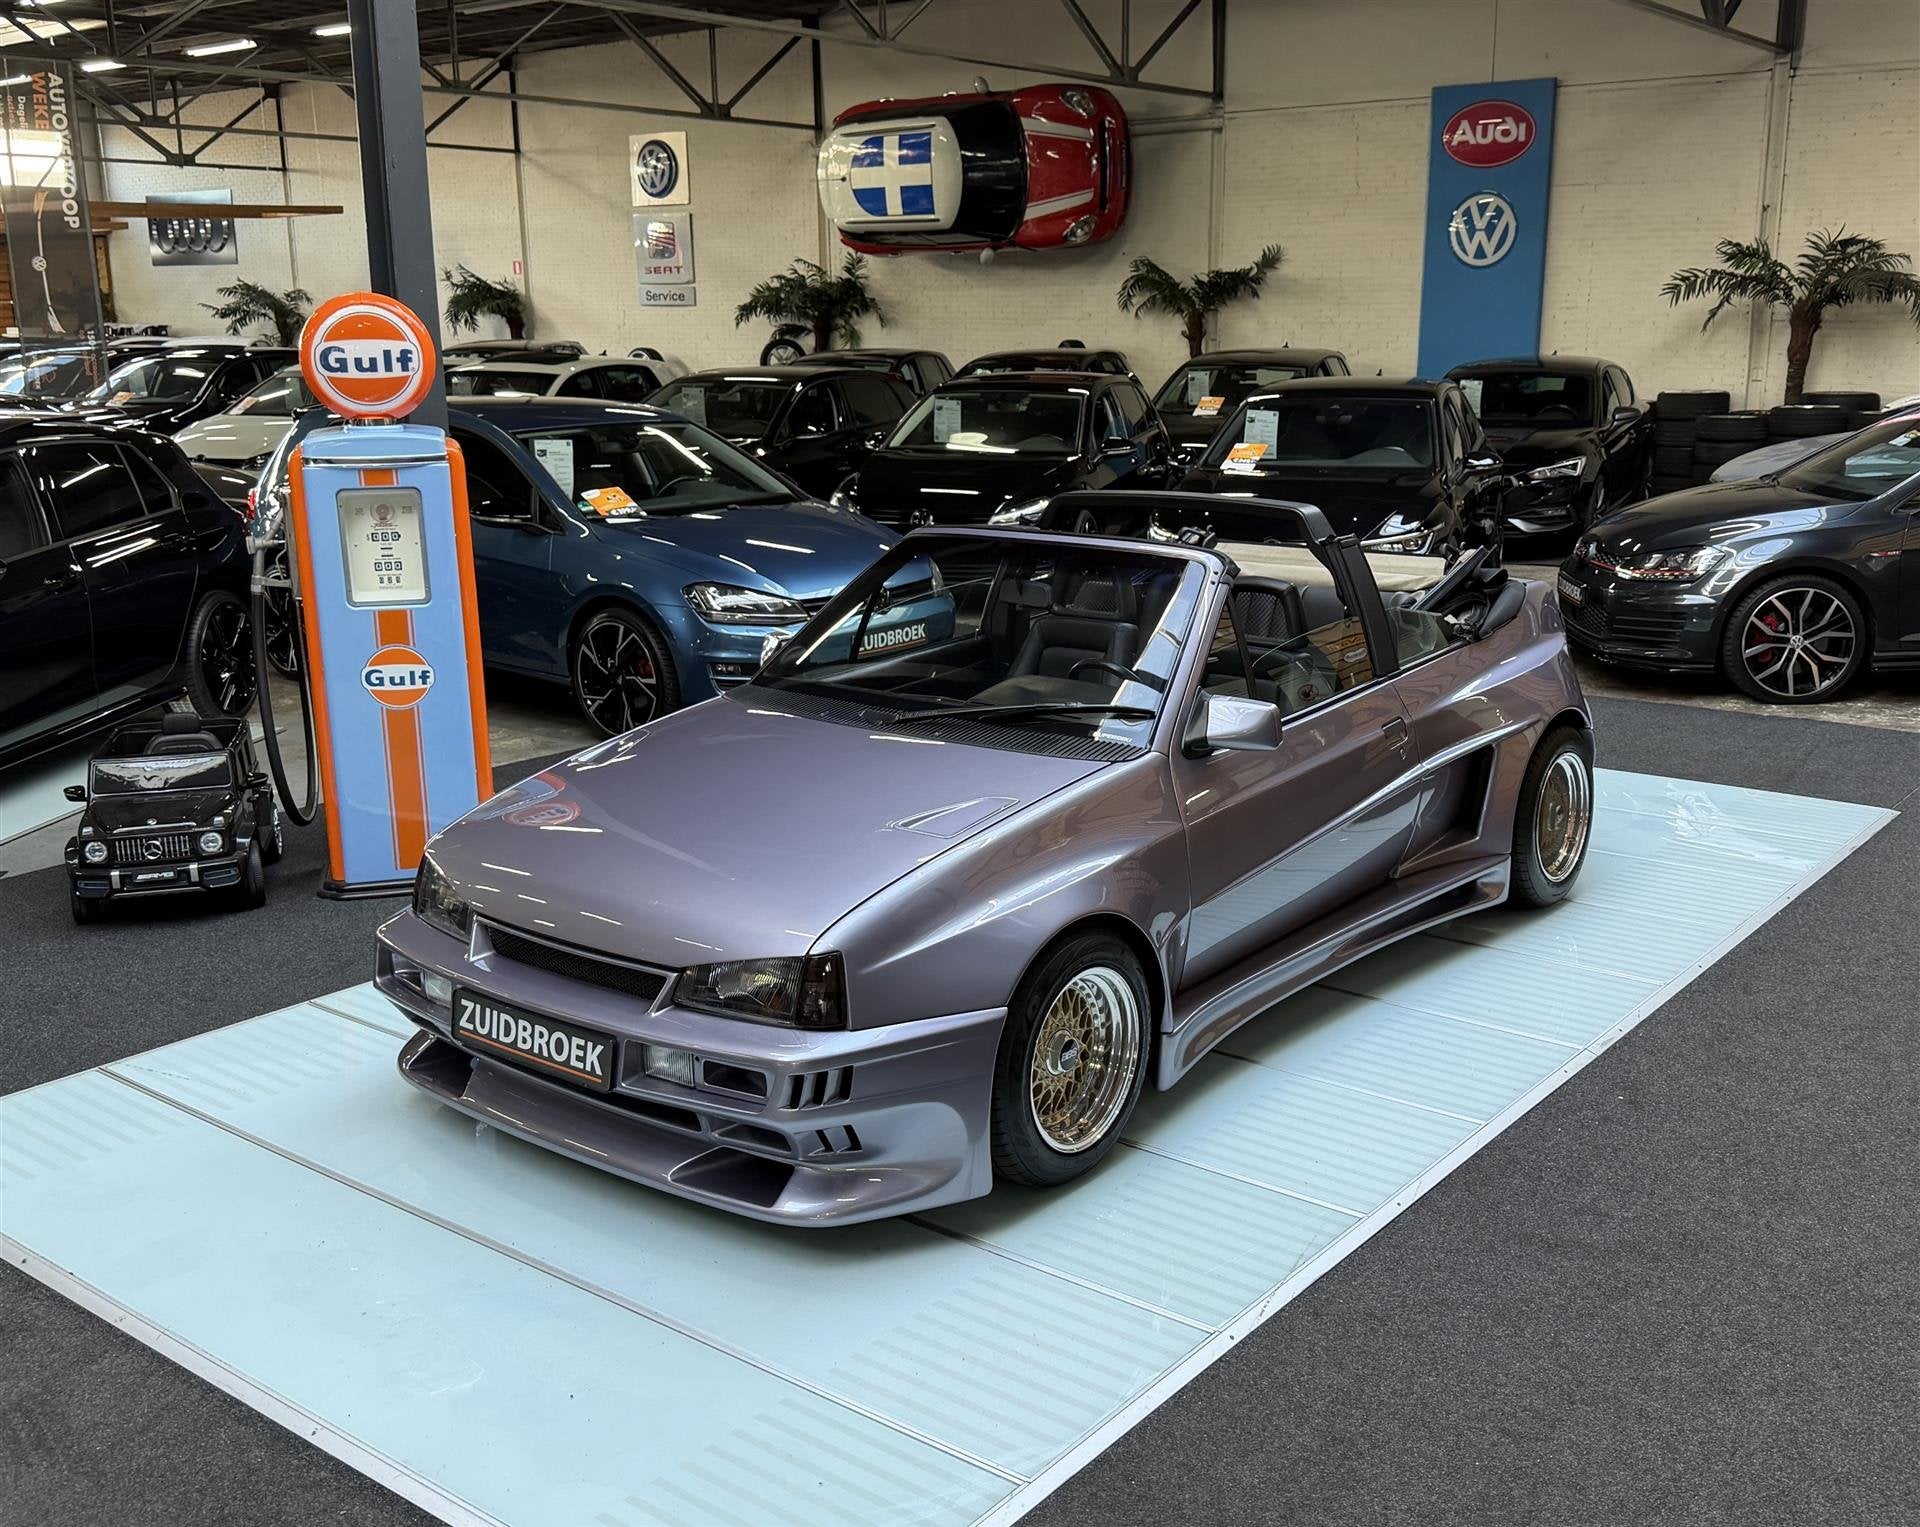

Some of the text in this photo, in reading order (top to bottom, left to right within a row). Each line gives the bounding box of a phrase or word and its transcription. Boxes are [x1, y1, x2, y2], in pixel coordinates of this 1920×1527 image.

[32, 71, 50, 129] WEKE
[644, 266, 683, 275] SEAT
[645, 290, 685, 302] Service
[320, 346, 413, 373] Gulf
[859, 623, 926, 652] UIDBROEK
[364, 669, 431, 687] Gulf
[459, 999, 605, 1076] ZUIDBROEK
